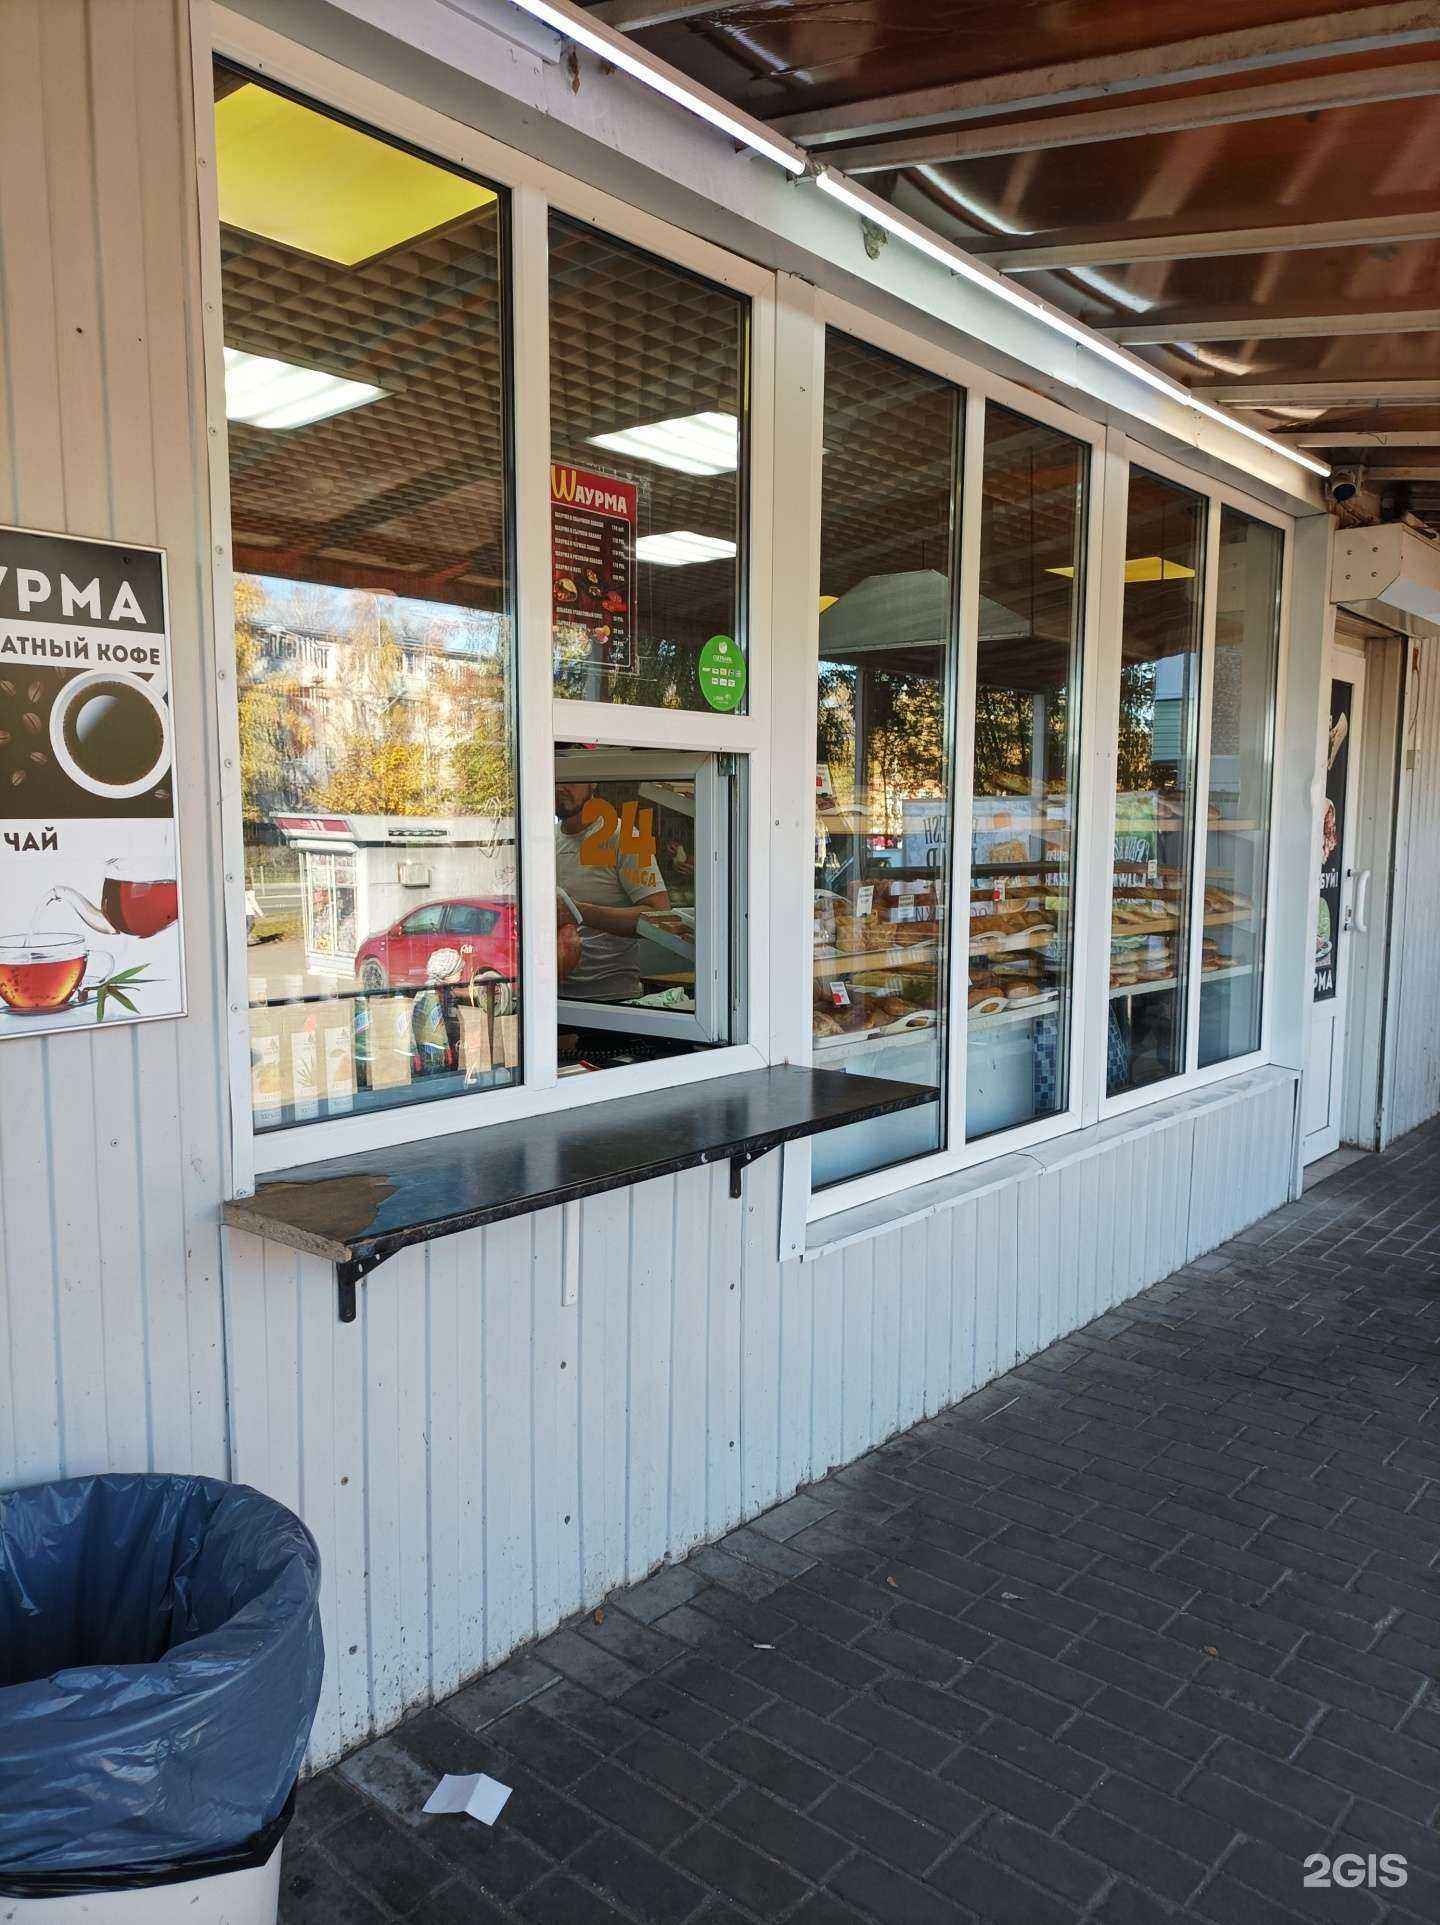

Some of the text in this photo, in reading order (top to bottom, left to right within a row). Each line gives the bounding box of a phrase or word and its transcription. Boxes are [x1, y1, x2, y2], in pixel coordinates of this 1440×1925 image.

[97, 643, 160, 665] КОФЕ
[4, 826, 58, 852] ЧАЙ
[579, 798, 657, 867] 24
